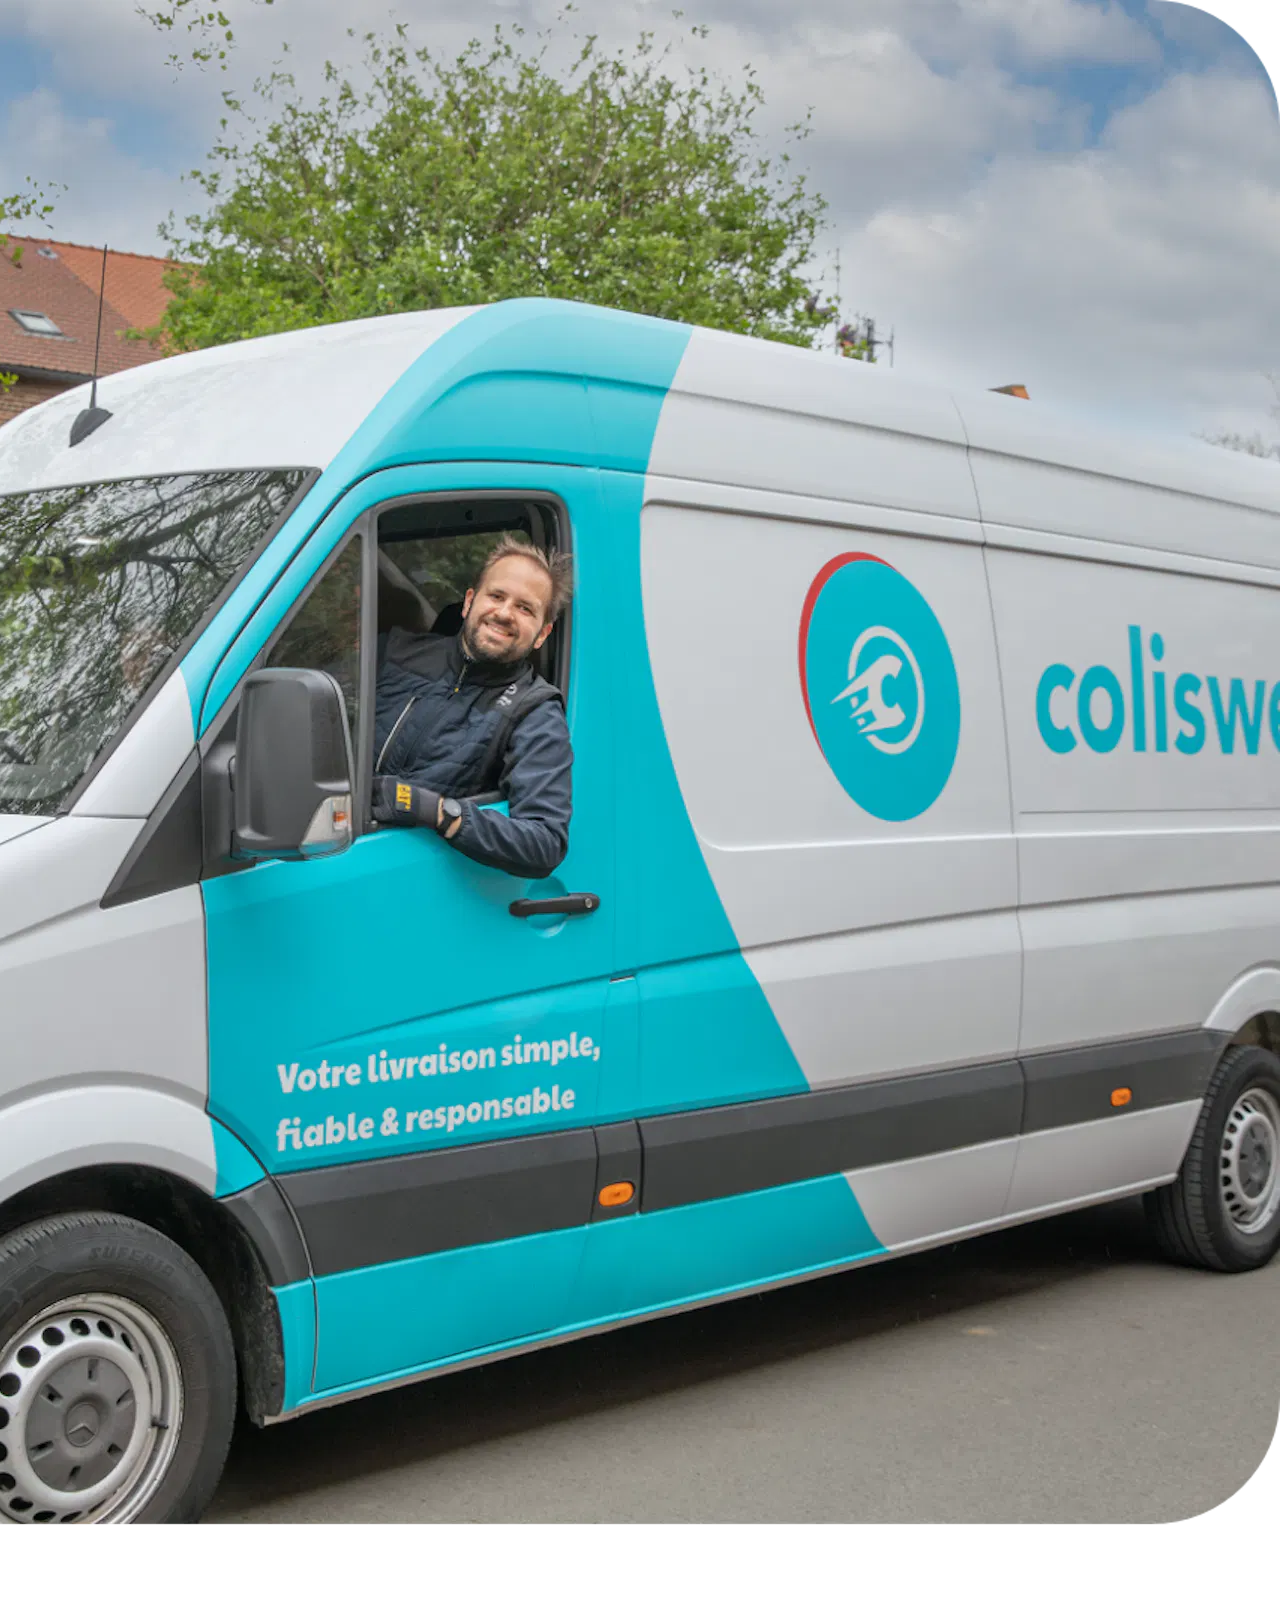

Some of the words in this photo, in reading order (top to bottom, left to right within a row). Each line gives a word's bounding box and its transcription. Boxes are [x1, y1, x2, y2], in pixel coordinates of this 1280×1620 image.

[1036, 624, 1280, 756] colisw
[277, 1060, 361, 1094] Votre
[368, 1043, 496, 1083] livraison
[501, 1031, 600, 1066] simple,
[277, 1112, 374, 1151] fiable
[380, 1107, 399, 1136] &
[405, 1084, 575, 1132] responsable
